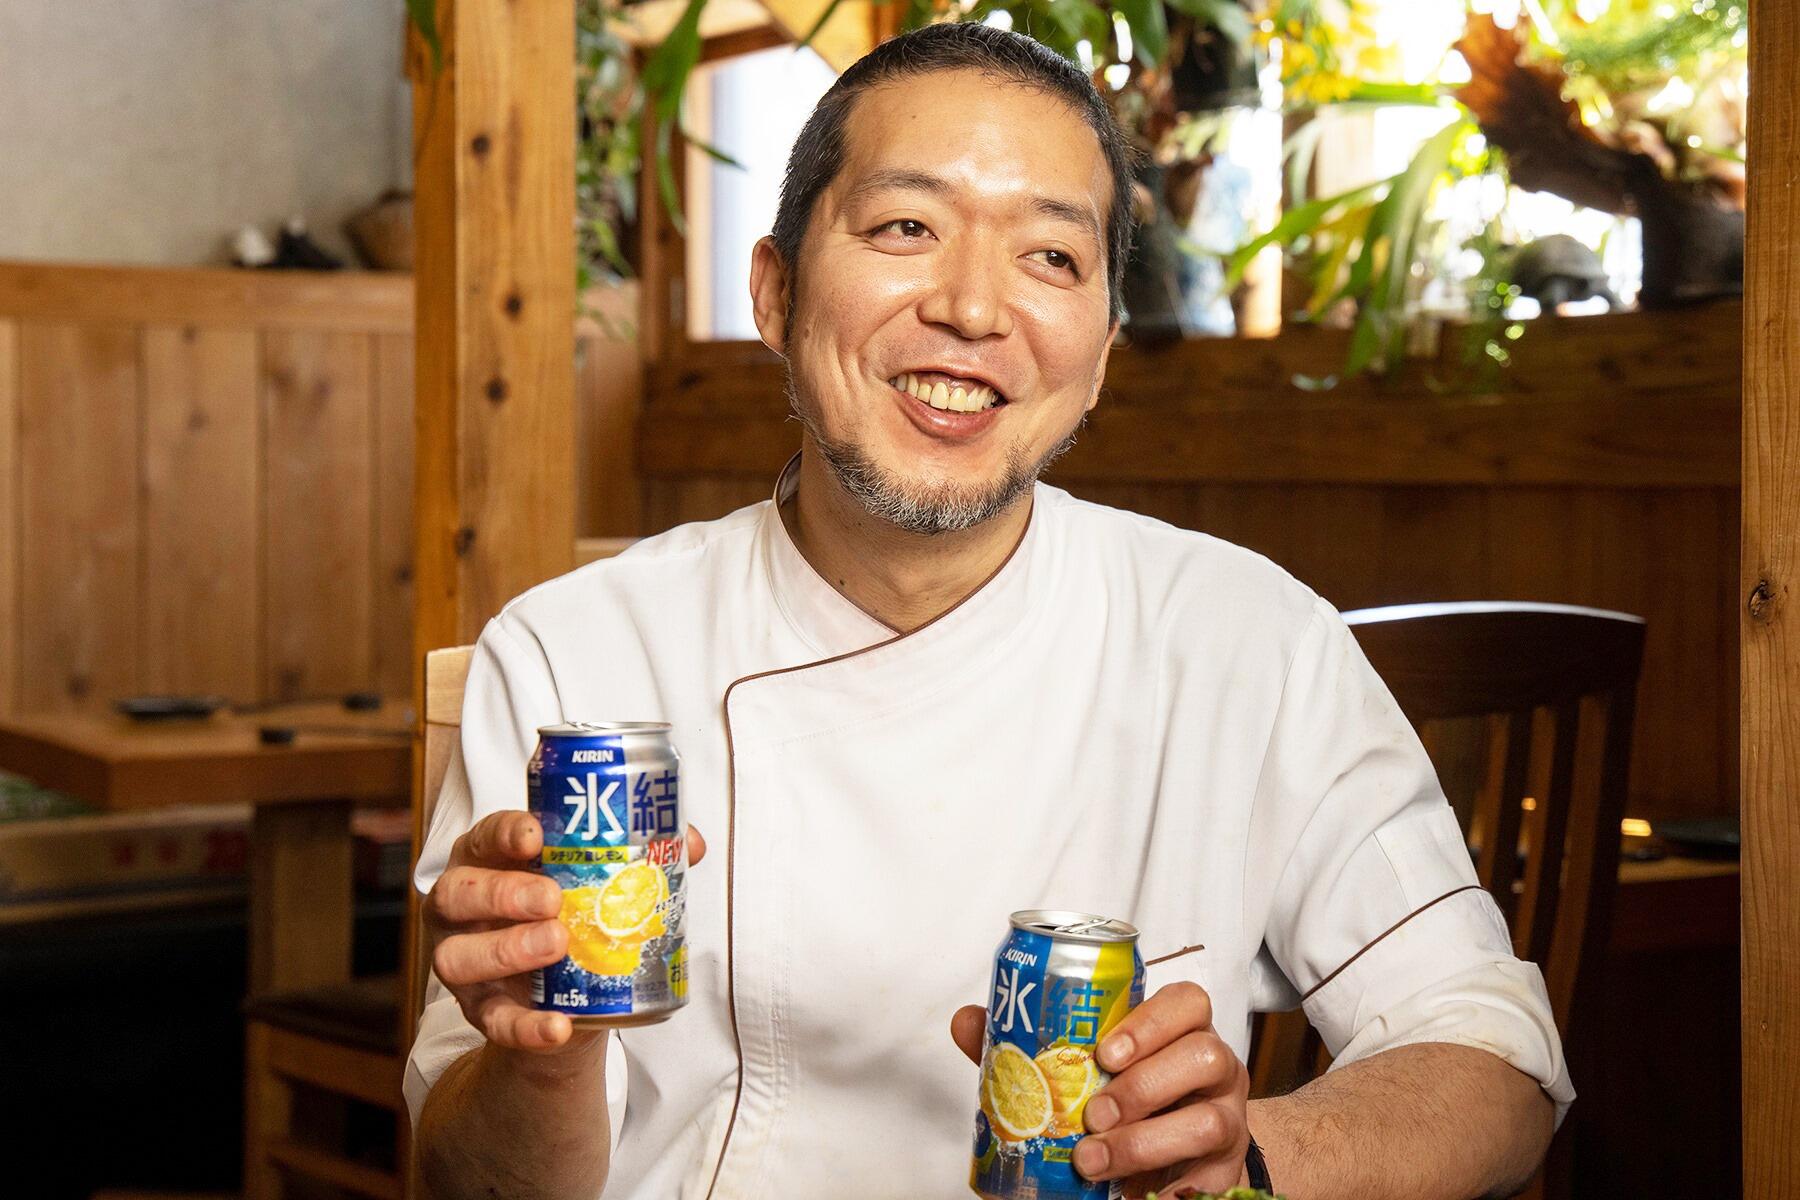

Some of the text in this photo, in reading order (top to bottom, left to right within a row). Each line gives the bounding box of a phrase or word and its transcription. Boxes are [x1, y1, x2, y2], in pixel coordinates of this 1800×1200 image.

[572, 750, 614, 763] KIRIN
[563, 769, 678, 841] 氷結
[1004, 948, 1038, 967] KIRIN
[993, 968, 1105, 1045] 氷結
